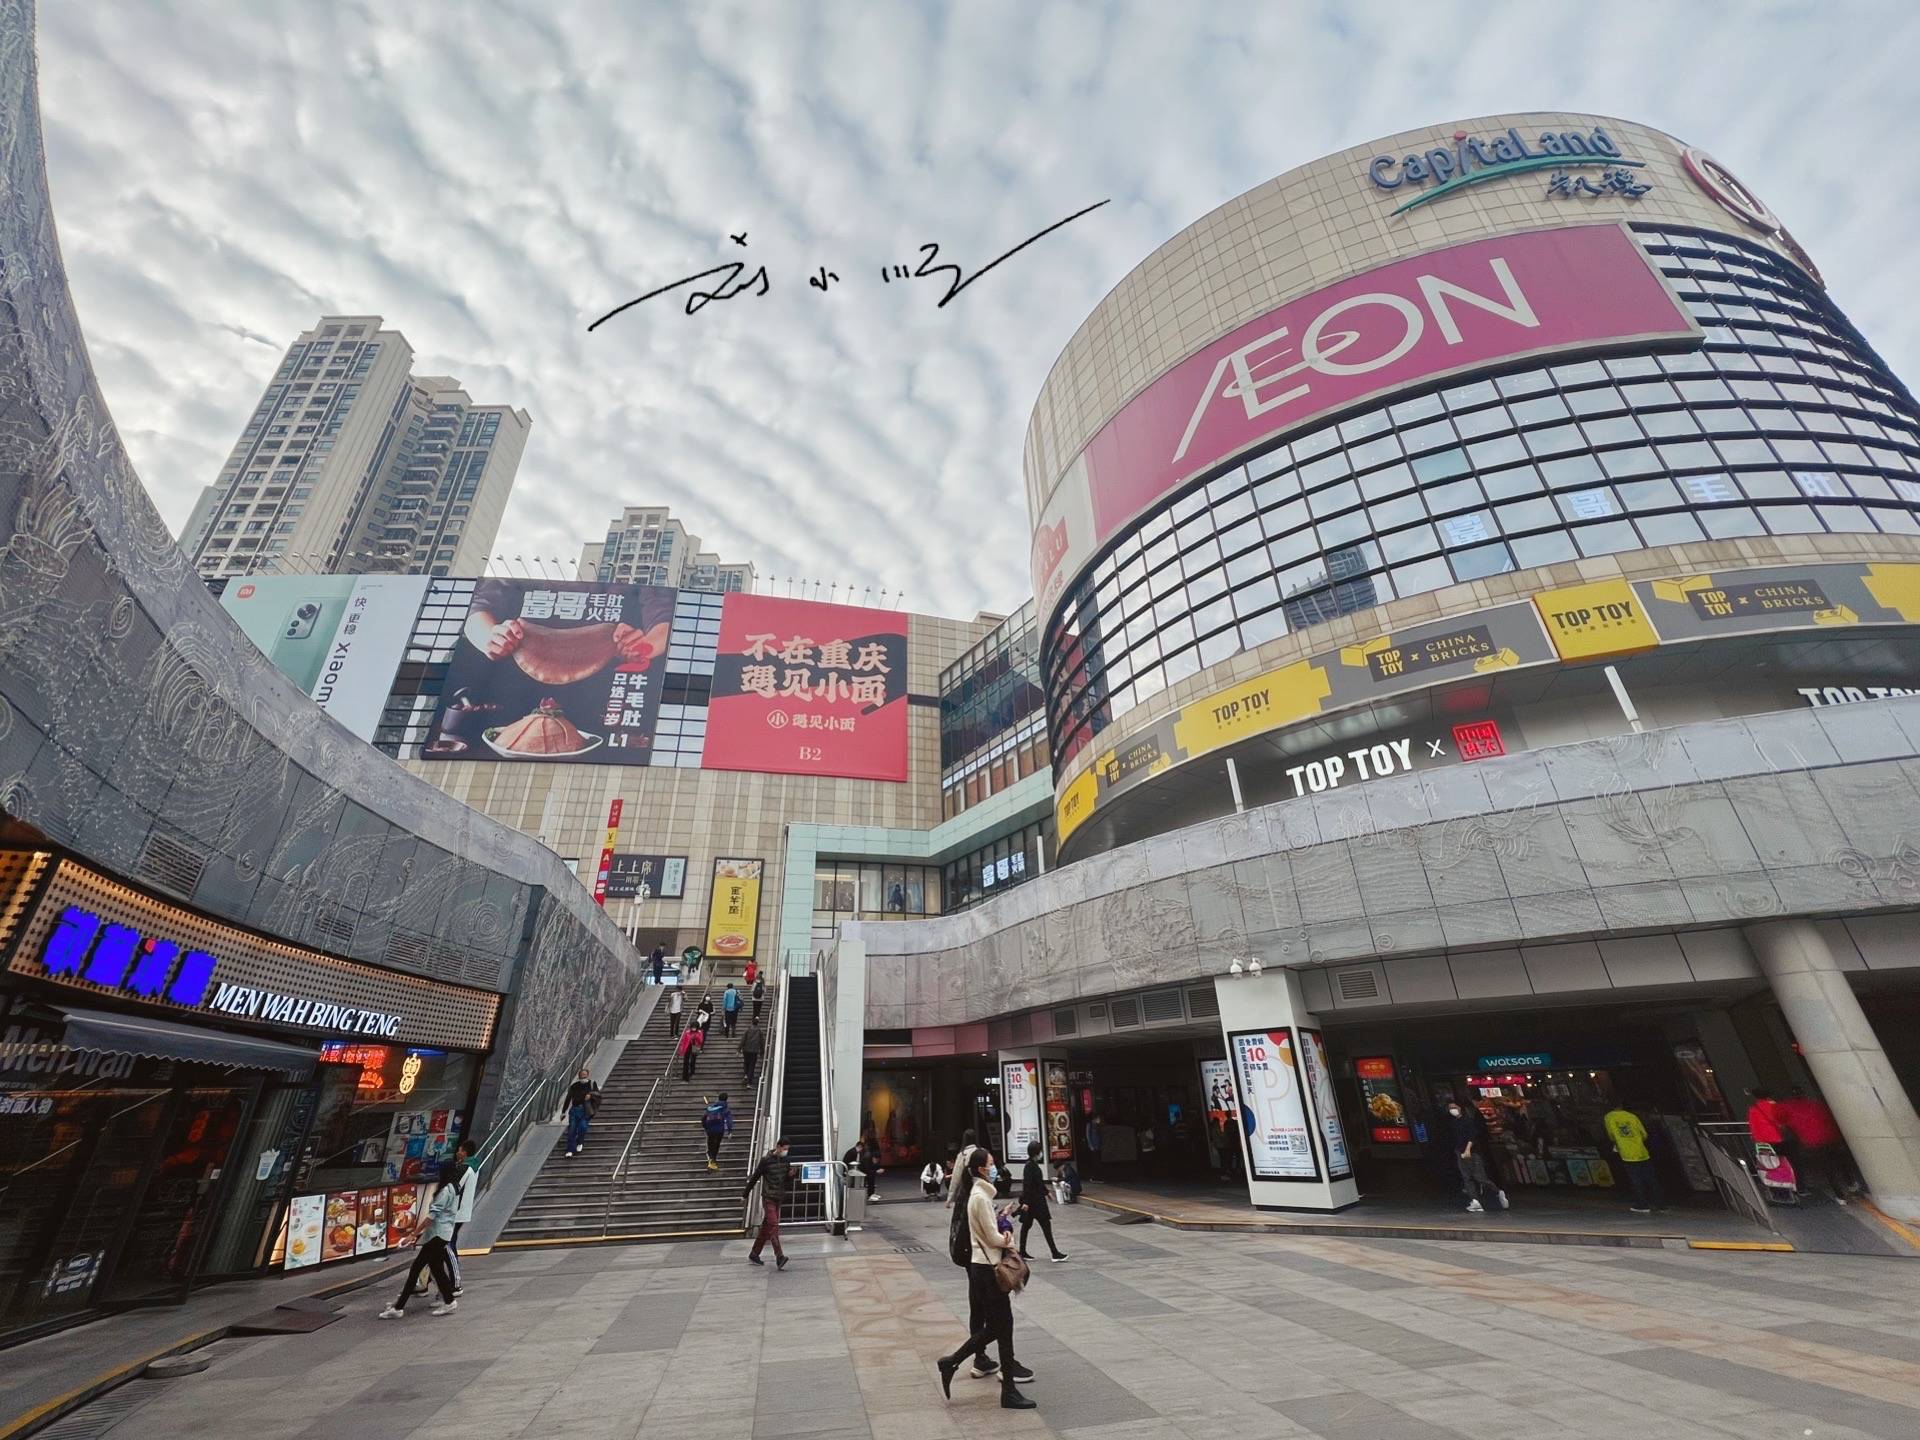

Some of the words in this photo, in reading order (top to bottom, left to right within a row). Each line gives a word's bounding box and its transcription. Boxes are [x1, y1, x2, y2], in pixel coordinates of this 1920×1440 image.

[1368, 126, 1622, 190] CapitaLand
[589, 593, 624, 608] 毛肚
[1697, 590, 1727, 605] TOP
[1754, 585, 1809, 598] CHINA
[1704, 602, 1734, 616] TOY
[1761, 595, 1825, 609] BRICKS
[586, 607, 622, 622] 火锅
[1551, 609, 1591, 629] TOP
[1592, 600, 1634, 622] TOY
[1425, 634, 1476, 652] CHINA
[1430, 642, 1490, 662] BRICKS
[742, 633, 892, 673] 不在重庆
[1376, 650, 1400, 665] TOP
[1380, 660, 1403, 676] TOY
[740, 664, 887, 707] 遇见小面
[604, 673, 627, 726] 只选三岁
[621, 673, 648, 727] 牛毛肚
[1212, 701, 1240, 723] TOP
[1241, 689, 1270, 712] TOY
[792, 713, 856, 732] 遇见小面
[607, 733, 627, 748] L1
[799, 746, 823, 761] B2
[1128, 743, 1152, 760] CHINA
[1130, 750, 1158, 769] BRICKS
[1285, 756, 1344, 797] TOP
[1347, 738, 1413, 781] TOY
[209, 982, 265, 1016] MEN
[260, 992, 312, 1024] WAH
[308, 1003, 355, 1031] BING
[353, 1010, 401, 1037] TENG
[1486, 1056, 1542, 1067] watsons
